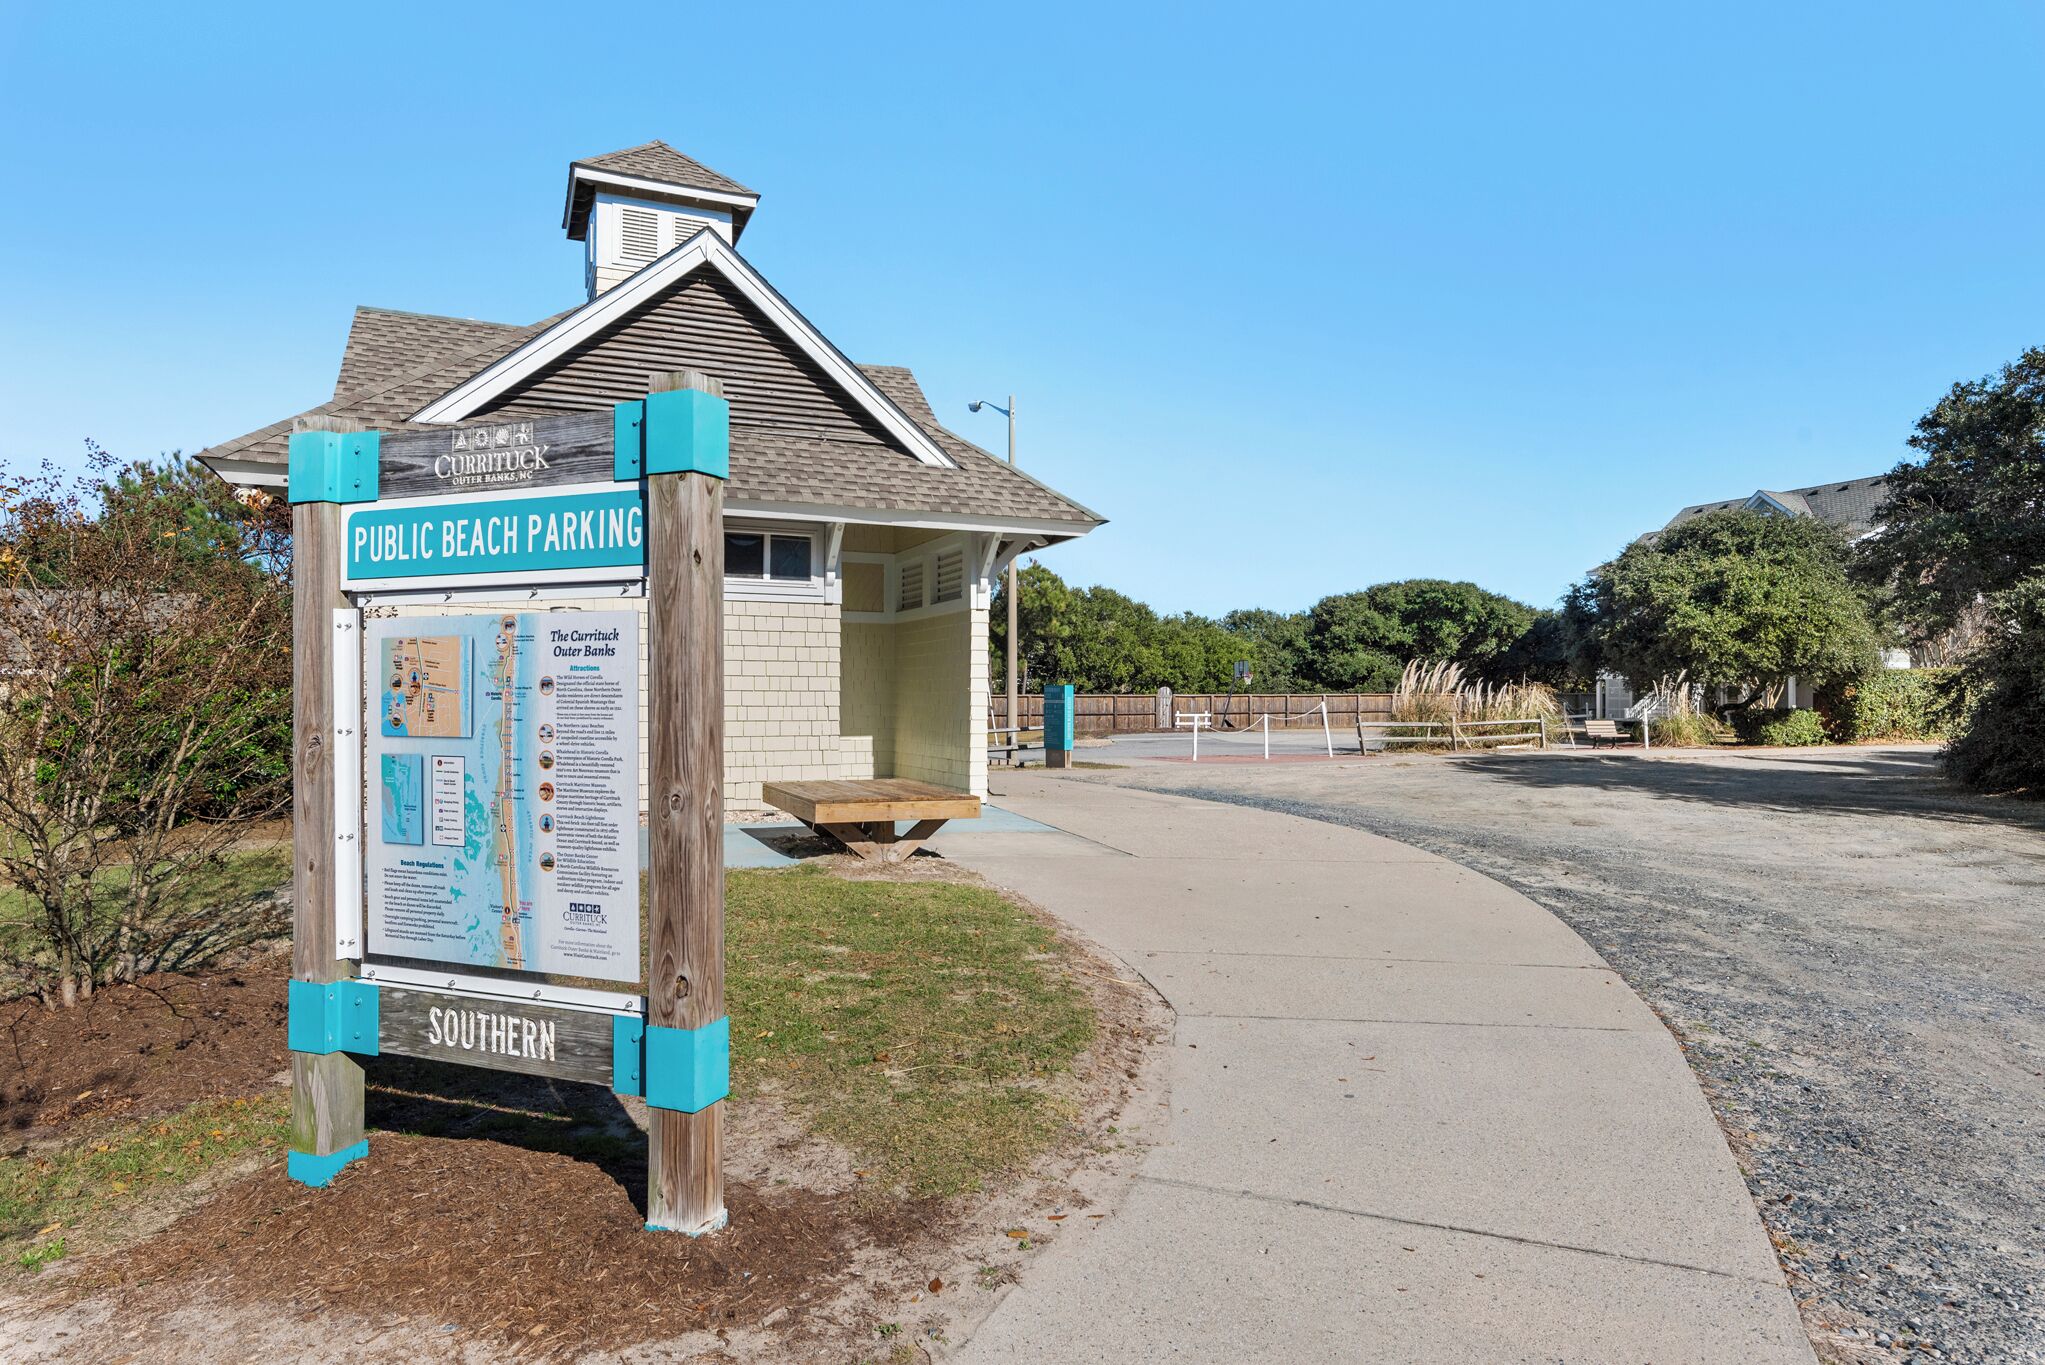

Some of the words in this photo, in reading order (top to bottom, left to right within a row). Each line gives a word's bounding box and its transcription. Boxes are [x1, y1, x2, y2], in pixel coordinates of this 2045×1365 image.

[434, 444, 551, 479] CURRITUCK
[452, 475, 482, 485] OUTER
[485, 472, 518, 483] BANKS,
[519, 470, 533, 480] NC
[354, 521, 434, 563] PUBLIC
[442, 515, 518, 558] BEACH
[527, 506, 642, 553] PARKING
[551, 629, 569, 643] The
[570, 628, 620, 642] Currituck
[553, 645, 582, 657] Outer
[584, 643, 616, 657] Banks
[562, 912, 608, 924] CURRITUCK
[428, 1005, 556, 1062] SOUTHERN
